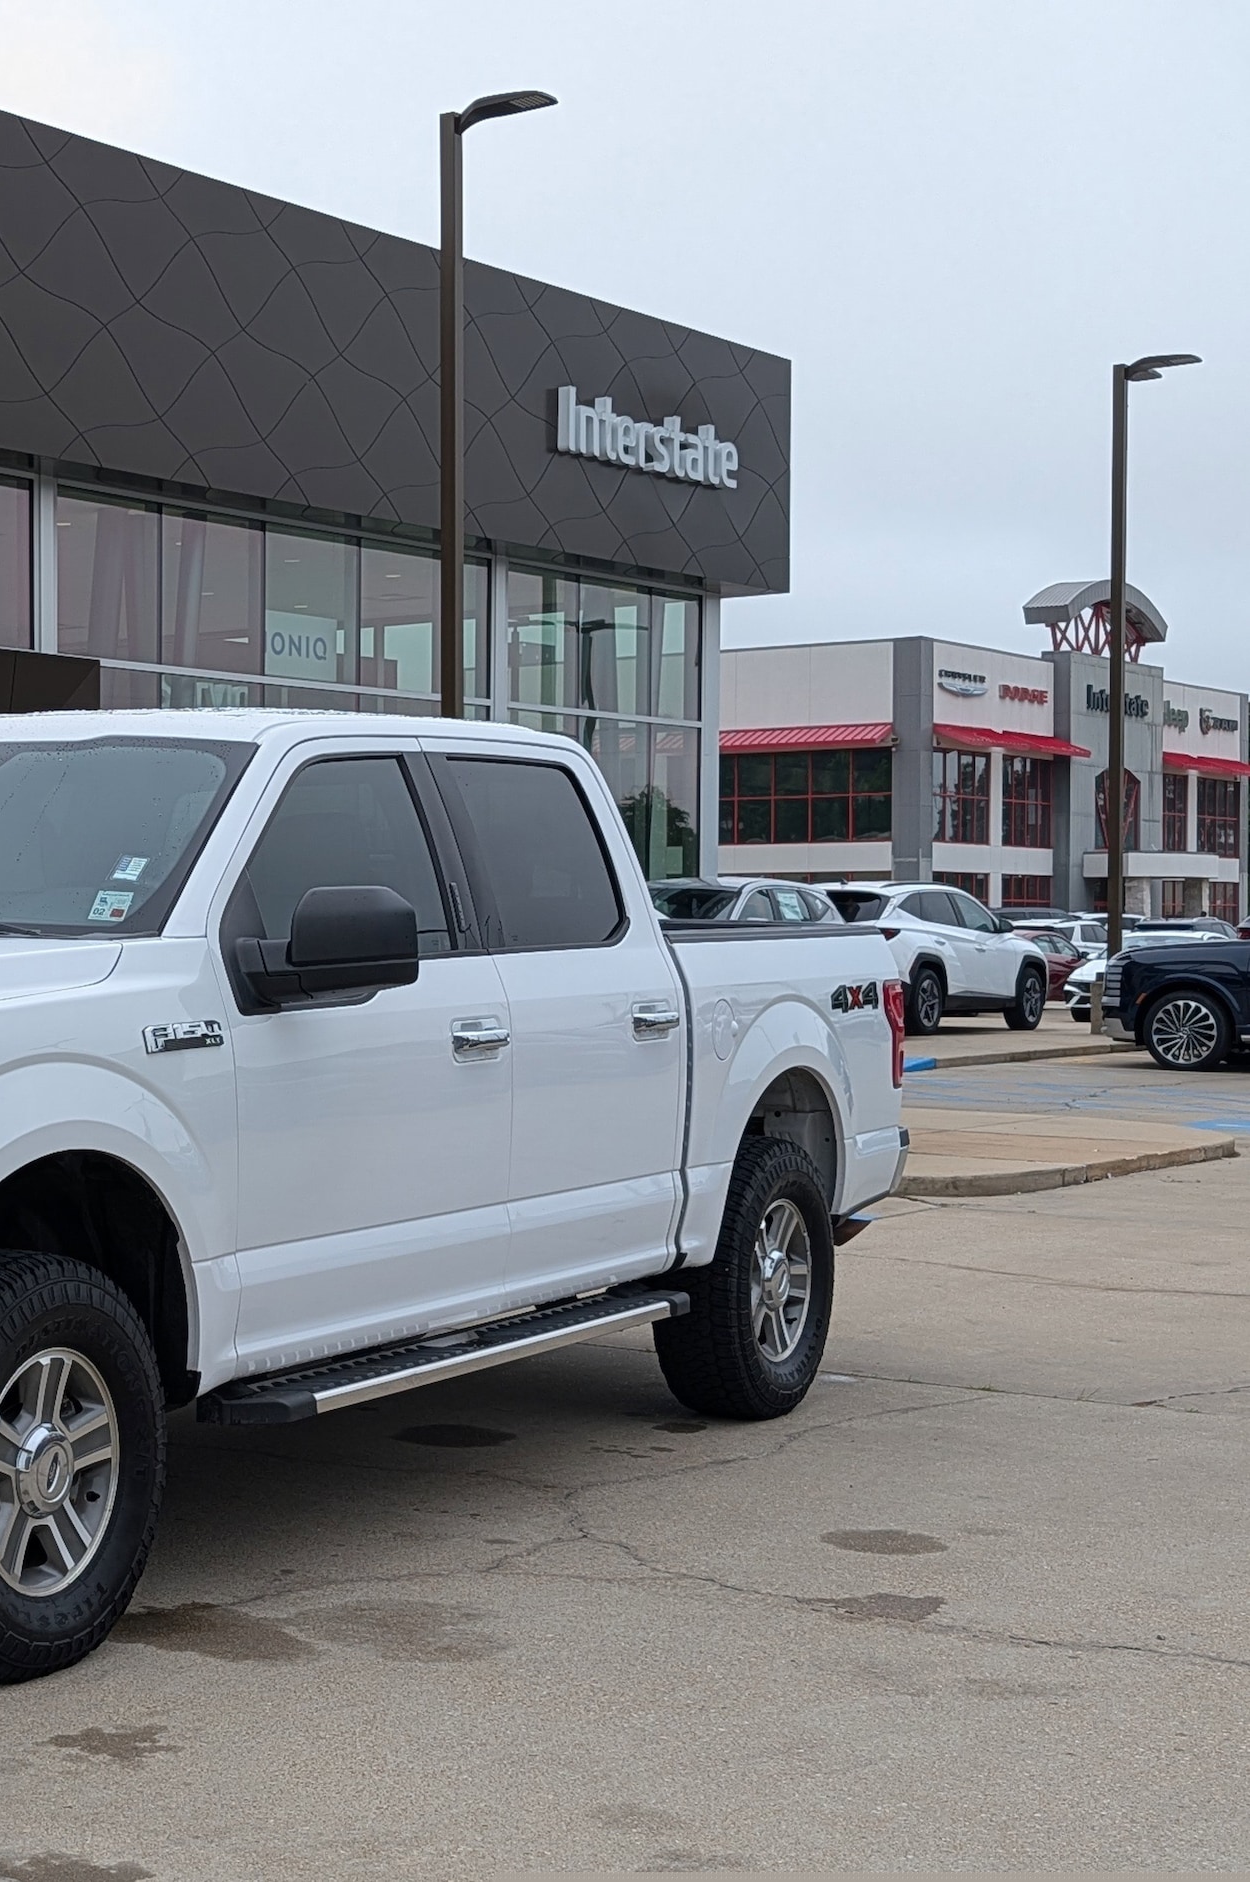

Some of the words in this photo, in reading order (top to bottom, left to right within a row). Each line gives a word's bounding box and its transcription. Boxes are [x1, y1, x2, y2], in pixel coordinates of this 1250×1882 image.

[557, 384, 739, 489] Interstate
[265, 631, 328, 661] ONIQ
[998, 684, 1049, 705] DODGE
[1086, 684, 1149, 718] Inttate
[1163, 700, 1189, 734] Jeep
[1211, 716, 1238, 731] RAM
[205, 1036, 222, 1046] XLT
